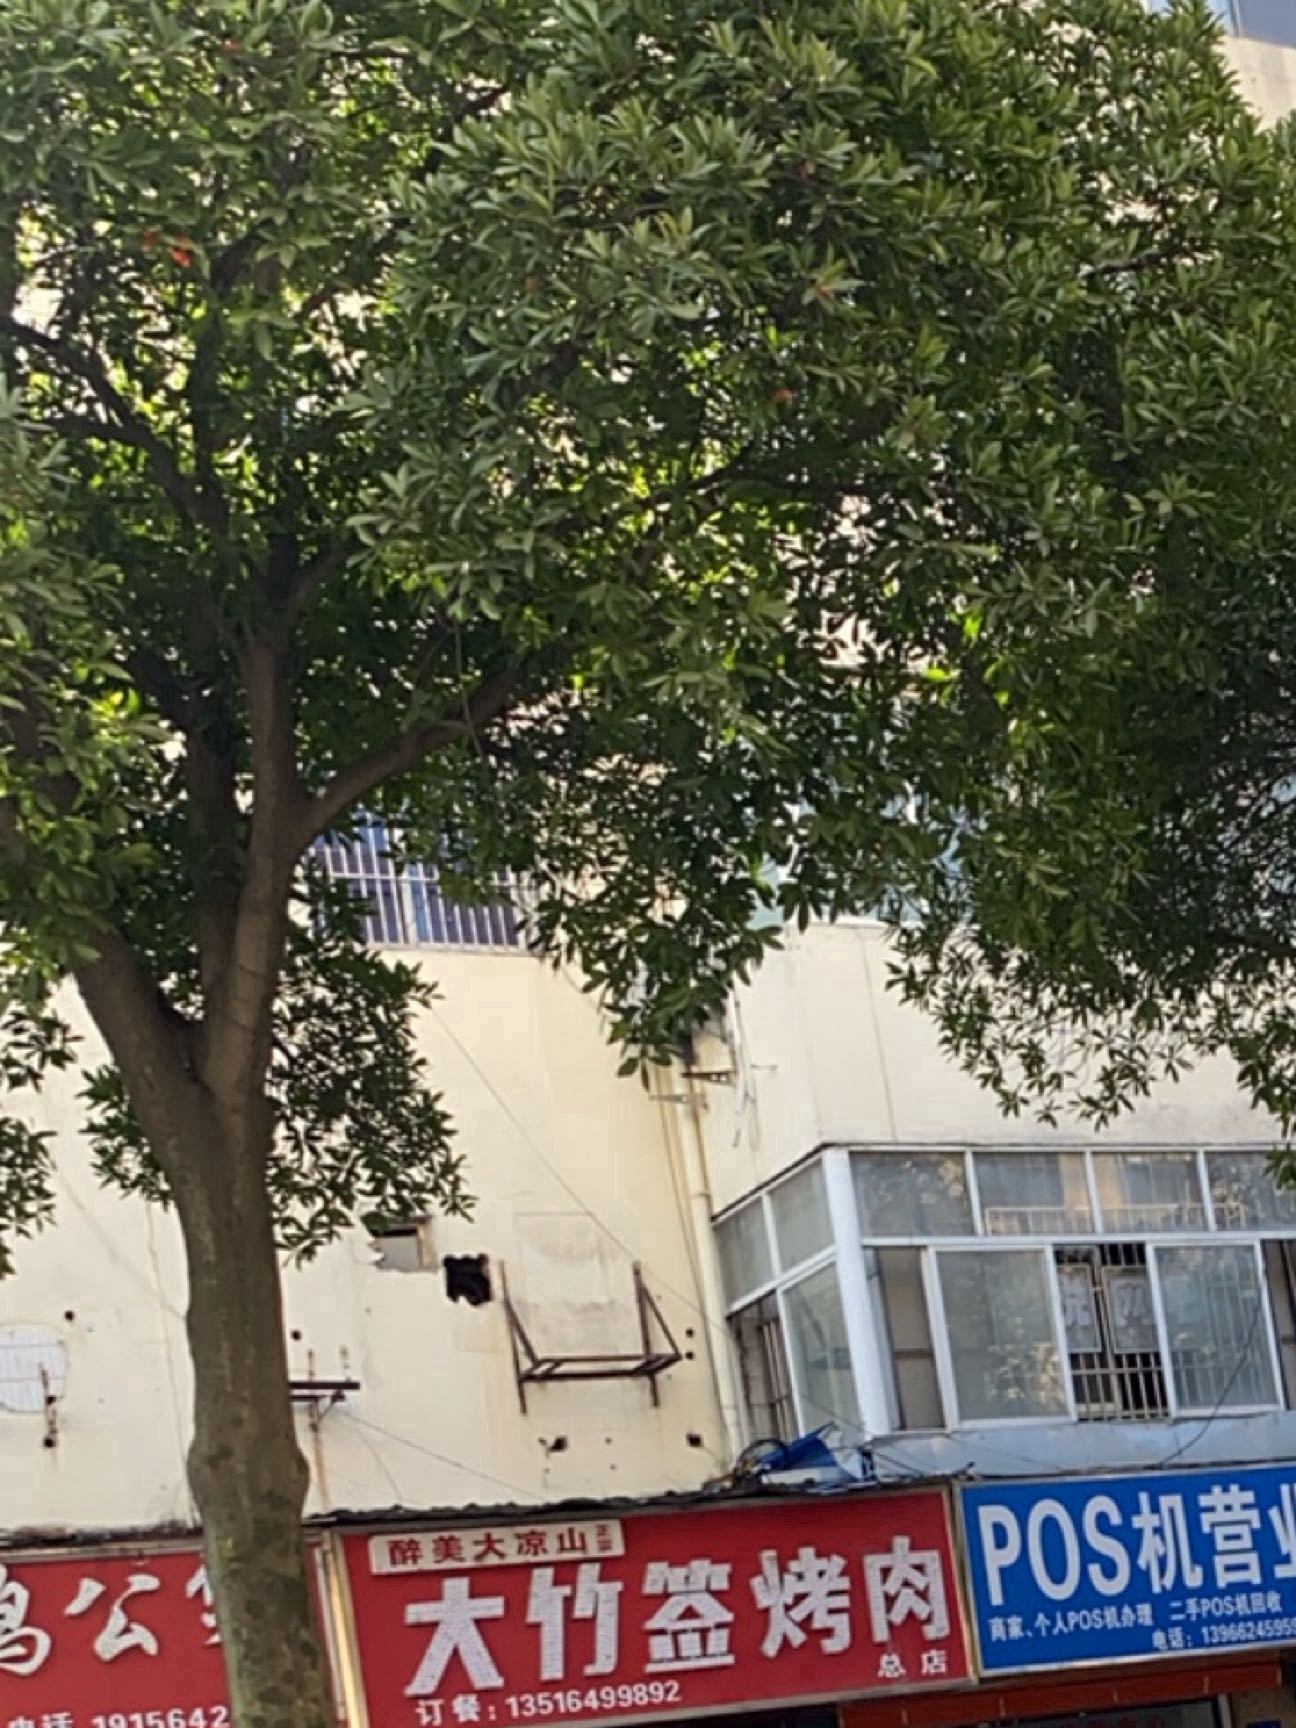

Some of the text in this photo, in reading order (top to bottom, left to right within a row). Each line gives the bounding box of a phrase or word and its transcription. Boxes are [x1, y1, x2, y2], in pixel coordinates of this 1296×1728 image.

[386, 1527, 588, 1566] 醉美大凉山
[403, 1536, 950, 1698] 大竹签烤肉
[878, 1648, 948, 1678] 总店
[505, 1679, 682, 1719] 13516499892
